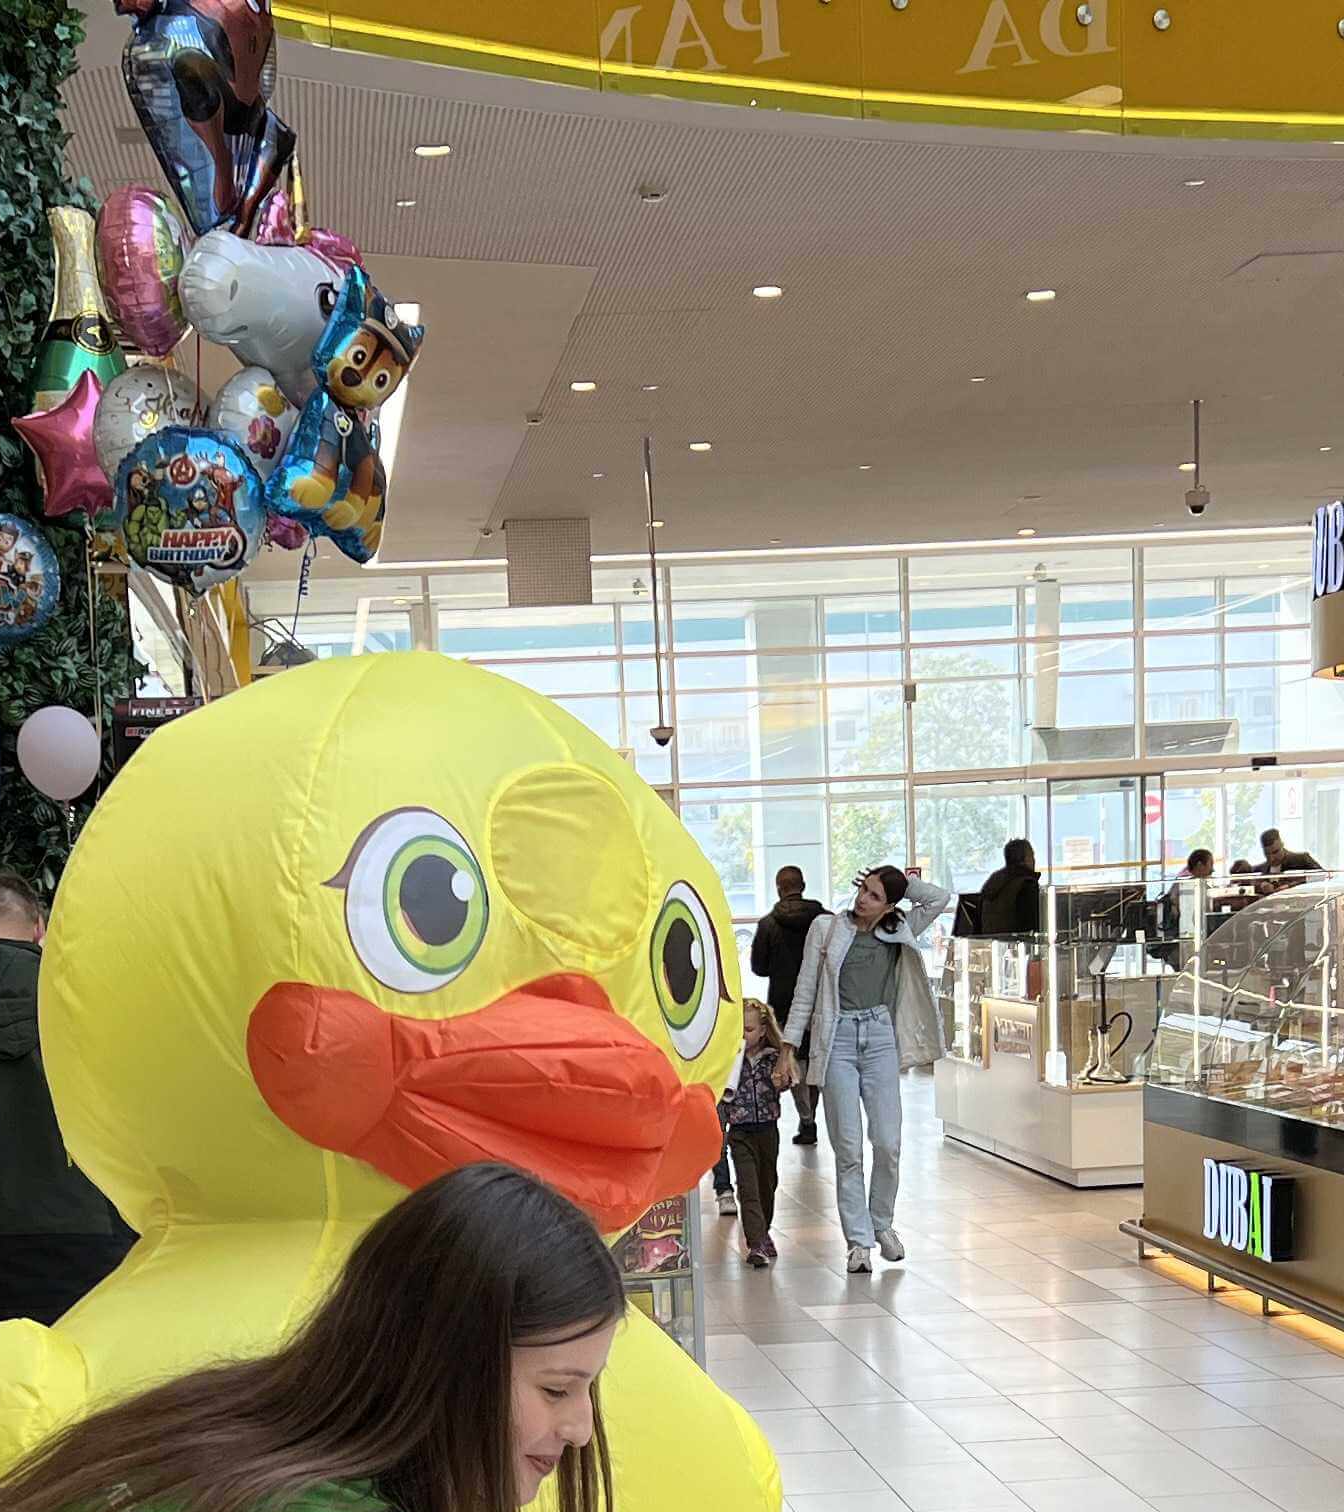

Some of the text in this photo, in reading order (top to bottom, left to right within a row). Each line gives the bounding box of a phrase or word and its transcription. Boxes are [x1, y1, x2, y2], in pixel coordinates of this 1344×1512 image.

[161, 529, 233, 548] HAPPY
[149, 547, 226, 562] BIRTHDAY
[1202, 1157, 1273, 1264] DUBAI
